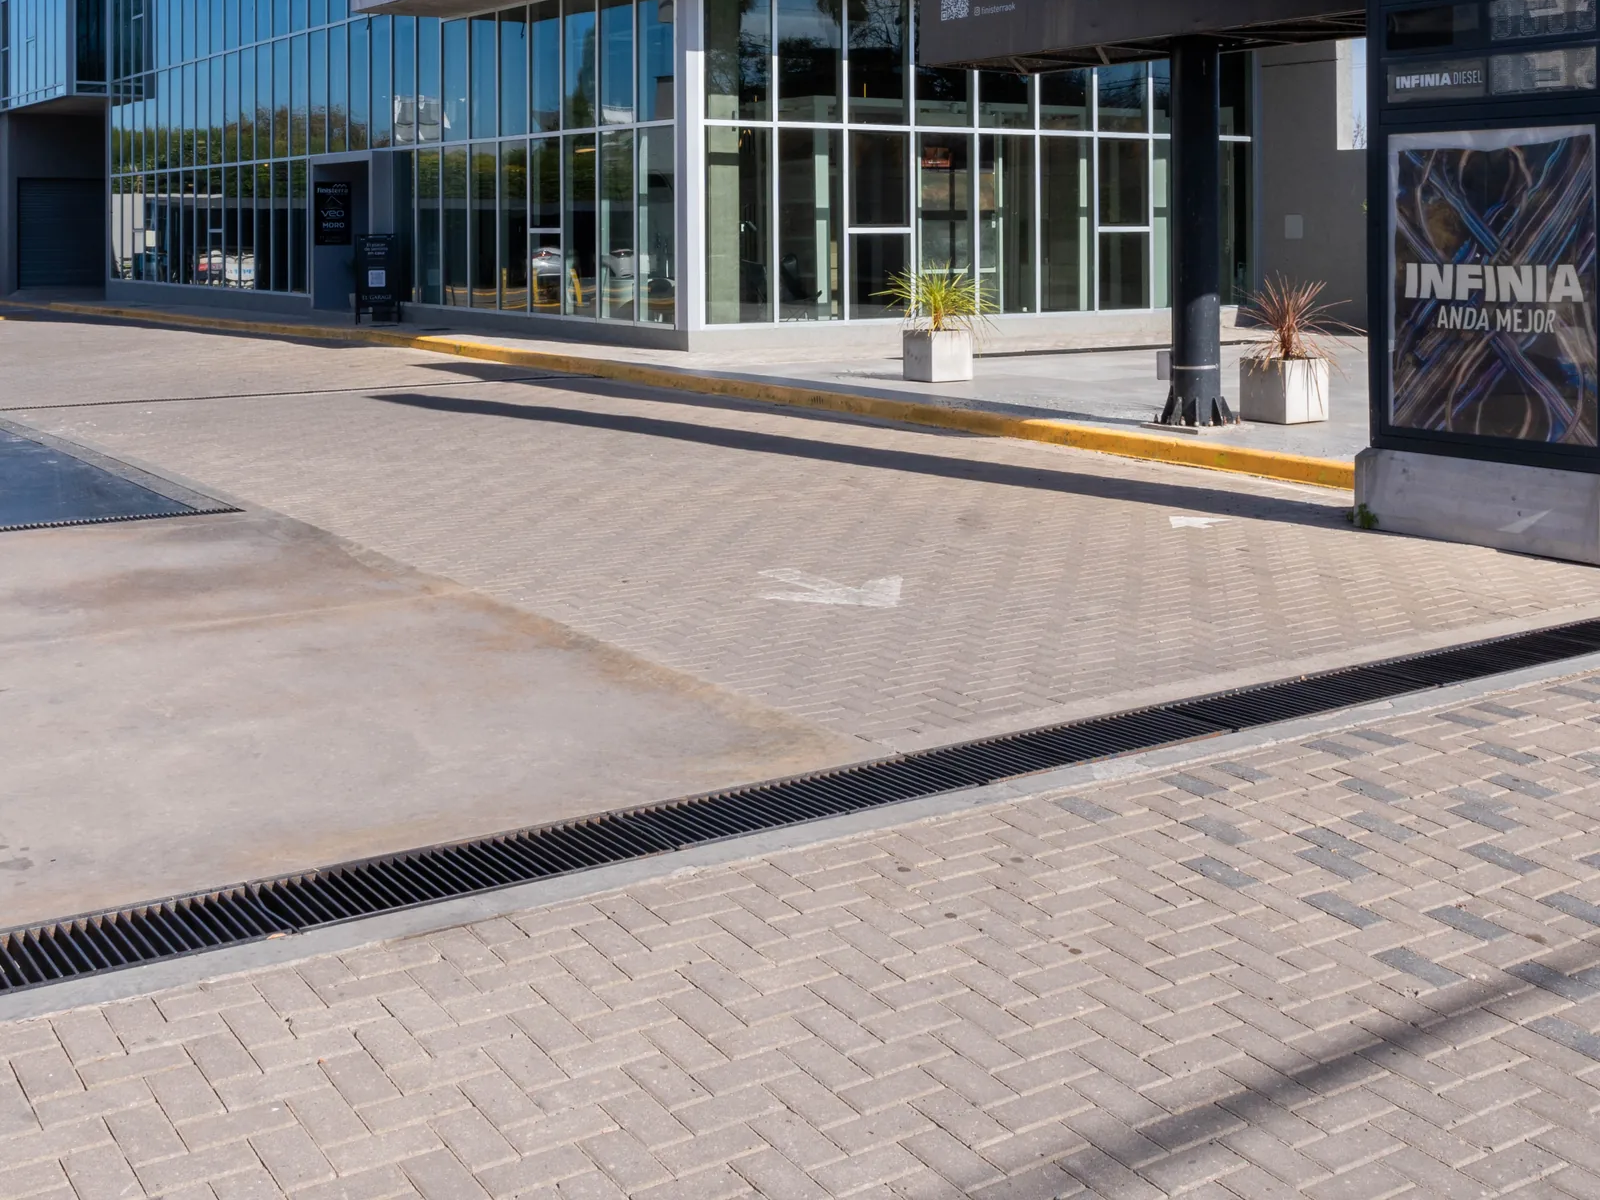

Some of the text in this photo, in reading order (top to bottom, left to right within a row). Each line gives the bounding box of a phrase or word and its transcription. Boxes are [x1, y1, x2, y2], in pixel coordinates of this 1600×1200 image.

[1395, 70, 1483, 89] INFINIA DIESEL
[316, 186, 349, 194] finisterra
[320, 209, 345, 218] veo
[1404, 262, 1585, 303] INFINIA
[1437, 305, 1556, 334] ANDA MEJOR
